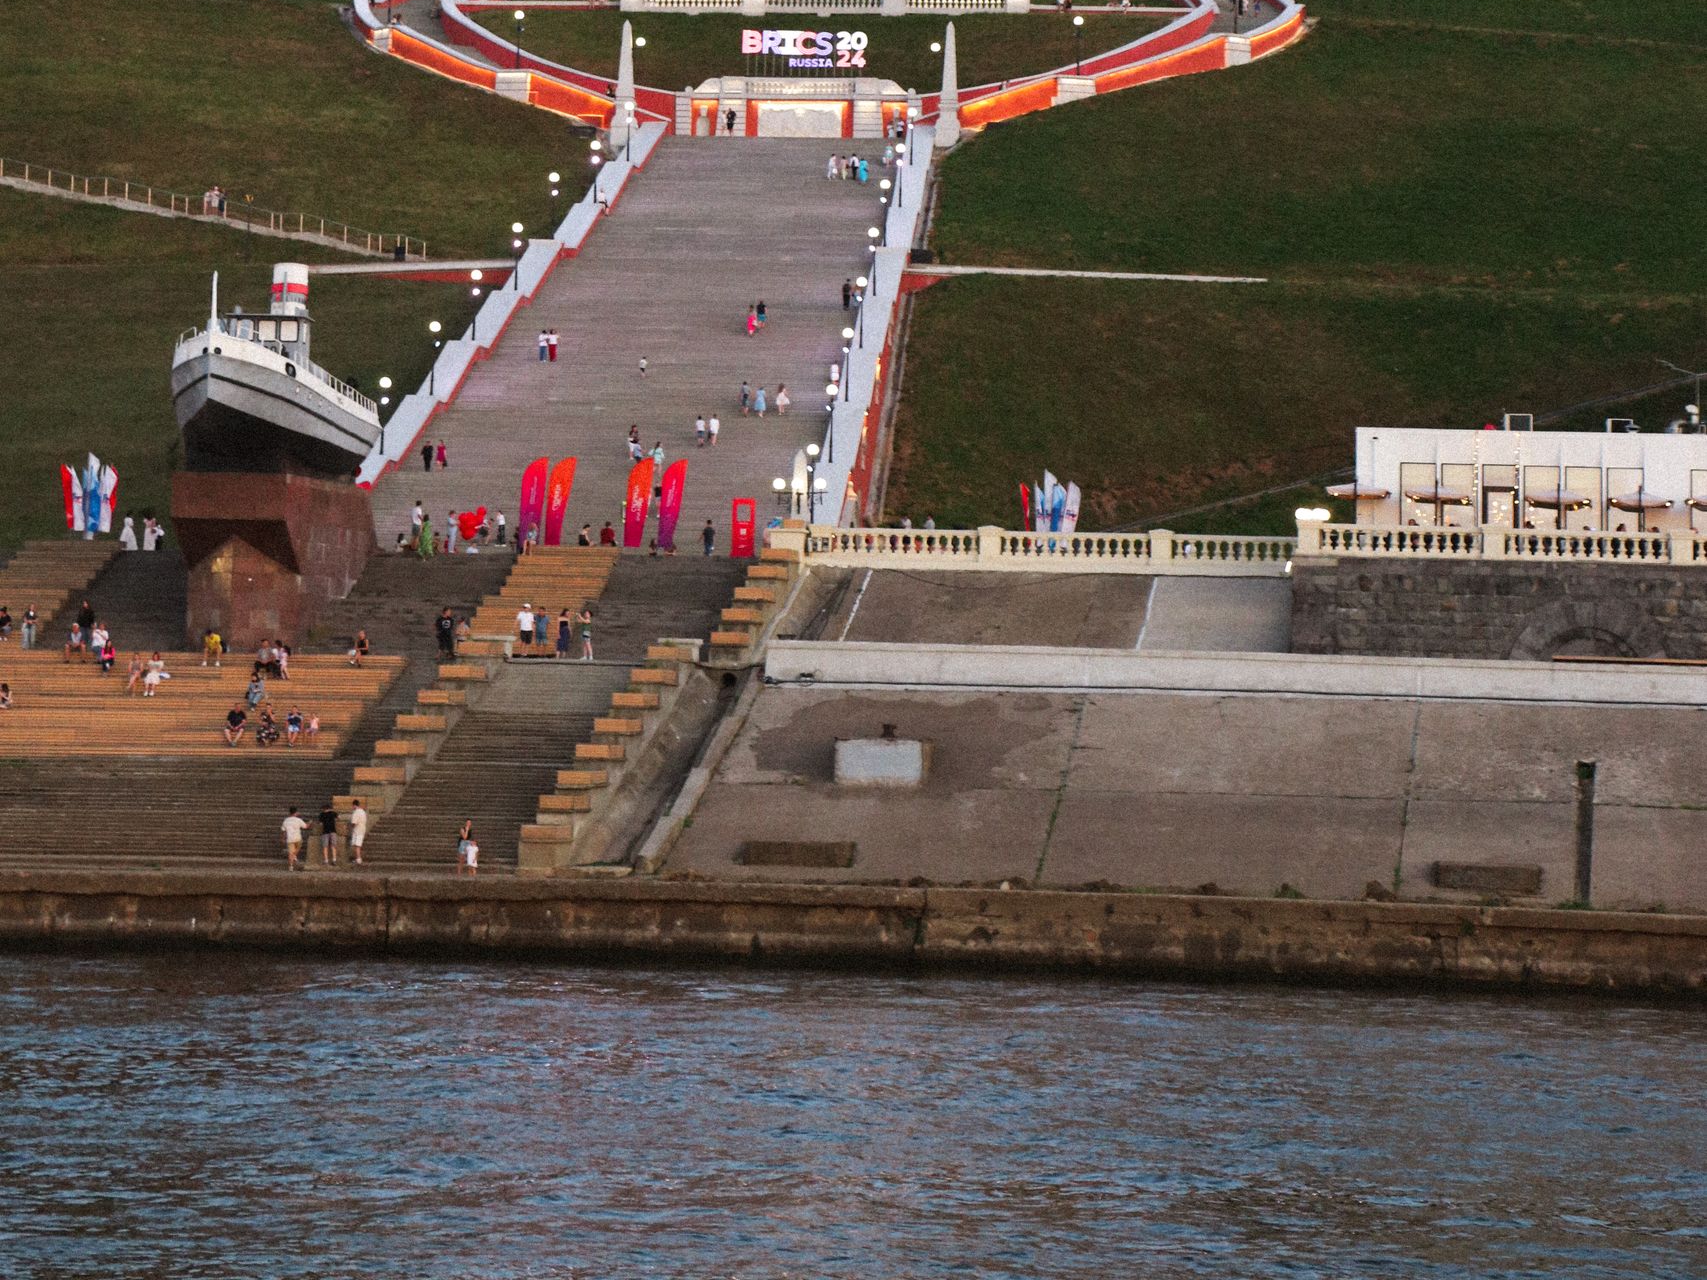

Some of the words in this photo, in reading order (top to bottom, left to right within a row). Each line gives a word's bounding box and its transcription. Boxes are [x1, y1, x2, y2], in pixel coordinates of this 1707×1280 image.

[741, 29, 834, 56] BRICS
[836, 30, 868, 51] 20
[788, 58, 834, 68] RUSSIA
[836, 50, 867, 68] 24
